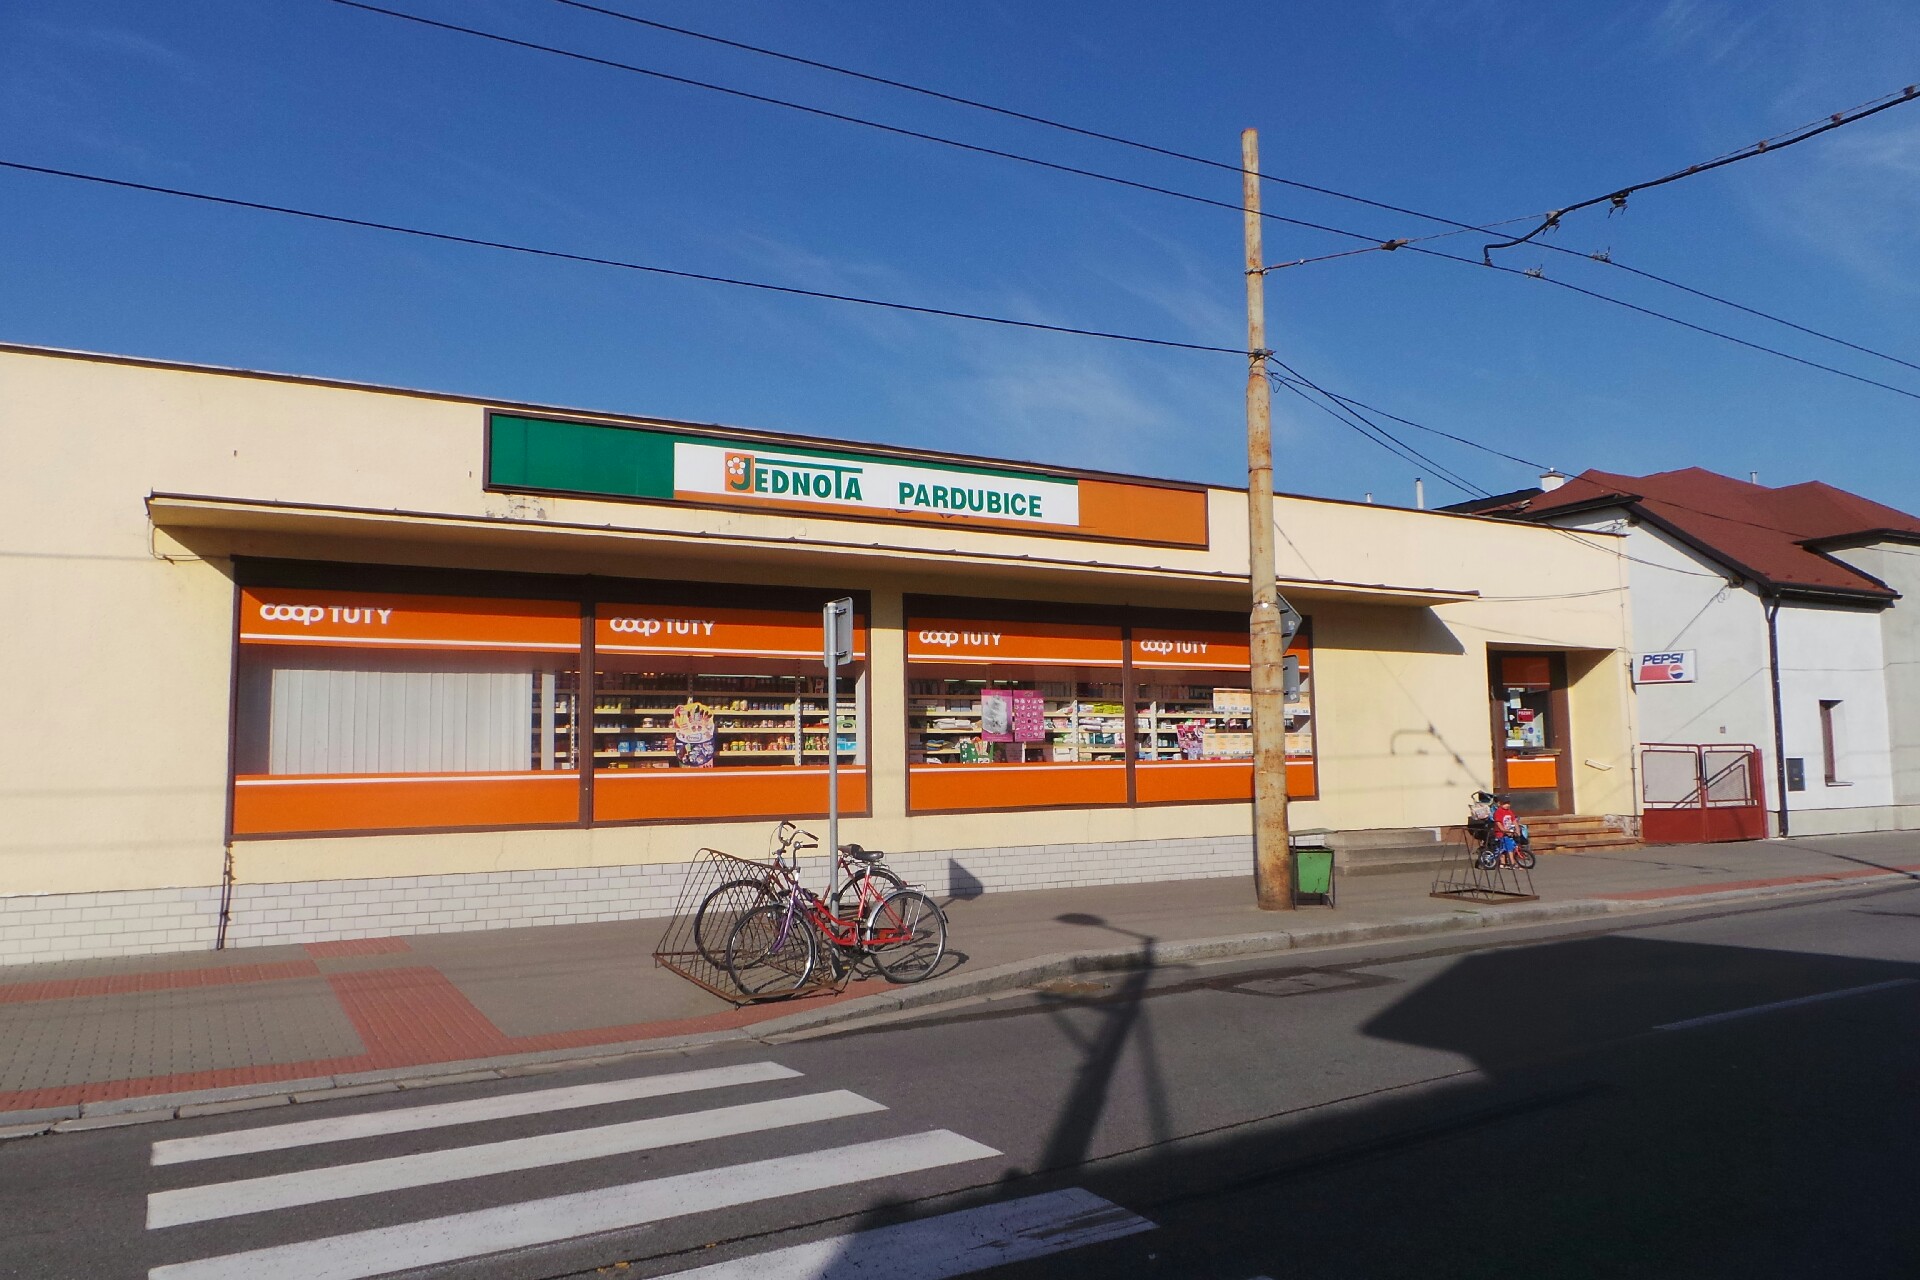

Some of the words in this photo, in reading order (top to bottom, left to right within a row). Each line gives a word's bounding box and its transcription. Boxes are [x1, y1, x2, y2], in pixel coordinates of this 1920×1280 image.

[729, 457, 863, 501] JEDNOTA
[898, 481, 1043, 518] PARDUBICE
[259, 603, 325, 626] coop
[328, 605, 393, 624] TUTY
[609, 616, 661, 637] coop
[664, 618, 715, 636] TUTY
[918, 630, 959, 648] coop
[961, 631, 1001, 646] TUTY
[1175, 640, 1208, 654] TUTY
[1642, 653, 1684, 665] PEPSI
